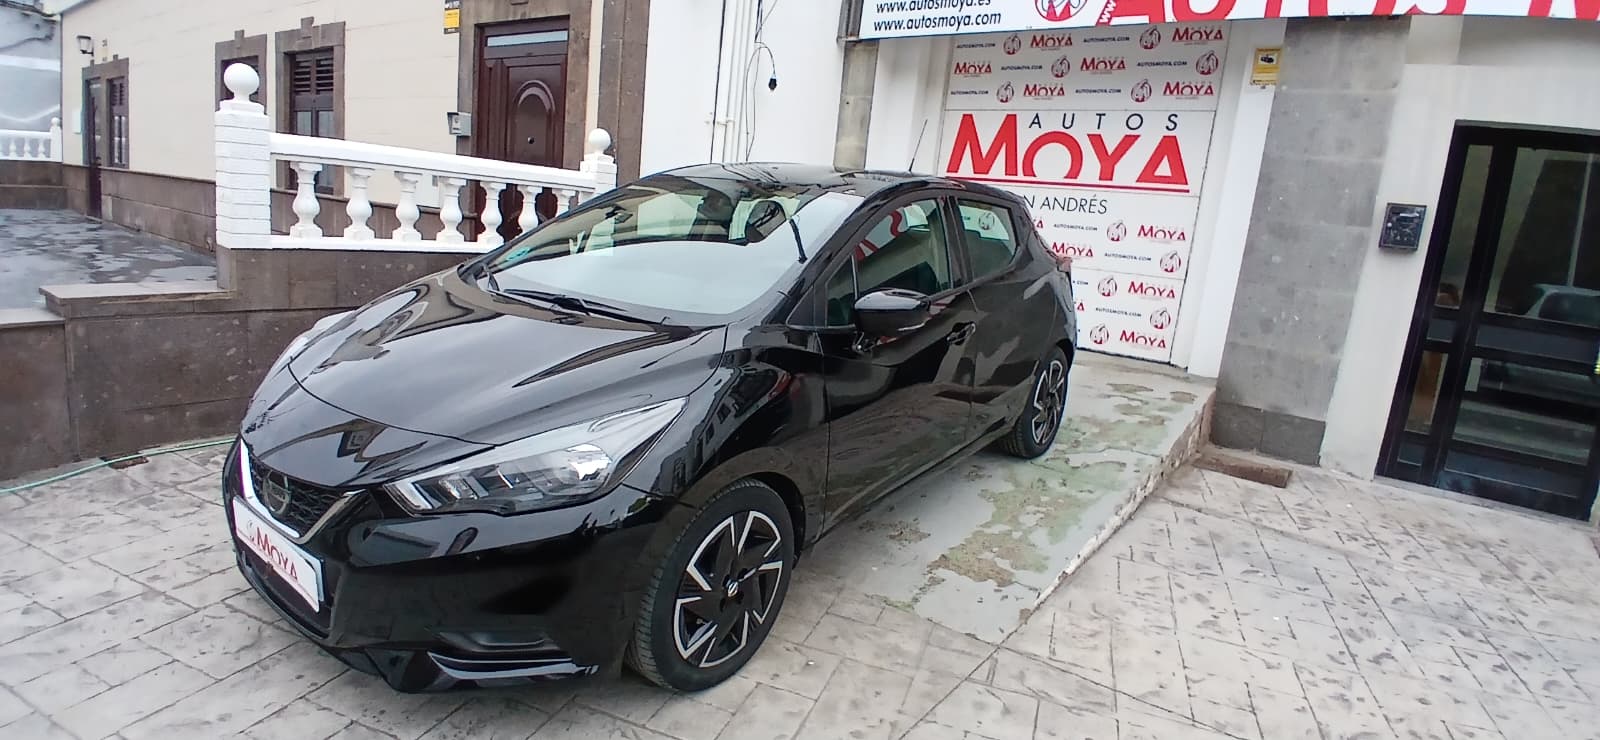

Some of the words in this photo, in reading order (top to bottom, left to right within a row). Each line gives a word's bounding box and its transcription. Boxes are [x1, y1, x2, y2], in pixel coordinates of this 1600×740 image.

[873, 12, 1002, 31] www.autosmoya.com
[1030, 34, 1073, 48] MOYA
[1172, 27, 1223, 42] MOYA
[954, 62, 992, 74] MOYA
[1080, 57, 1126, 71] MOYA
[1023, 84, 1065, 97] MOYA
[1163, 81, 1214, 96] MOYA
[1028, 112, 1179, 131] AUTOS
[946, 113, 1189, 185] MOYA
[1039, 194, 1108, 214] ANDRÉS
[1137, 224, 1186, 241] MOYA
[1051, 241, 1094, 257] MOYA
[1128, 281, 1175, 299] MOYA
[1119, 329, 1166, 348] MOYA
[256, 526, 298, 581] MOYA
